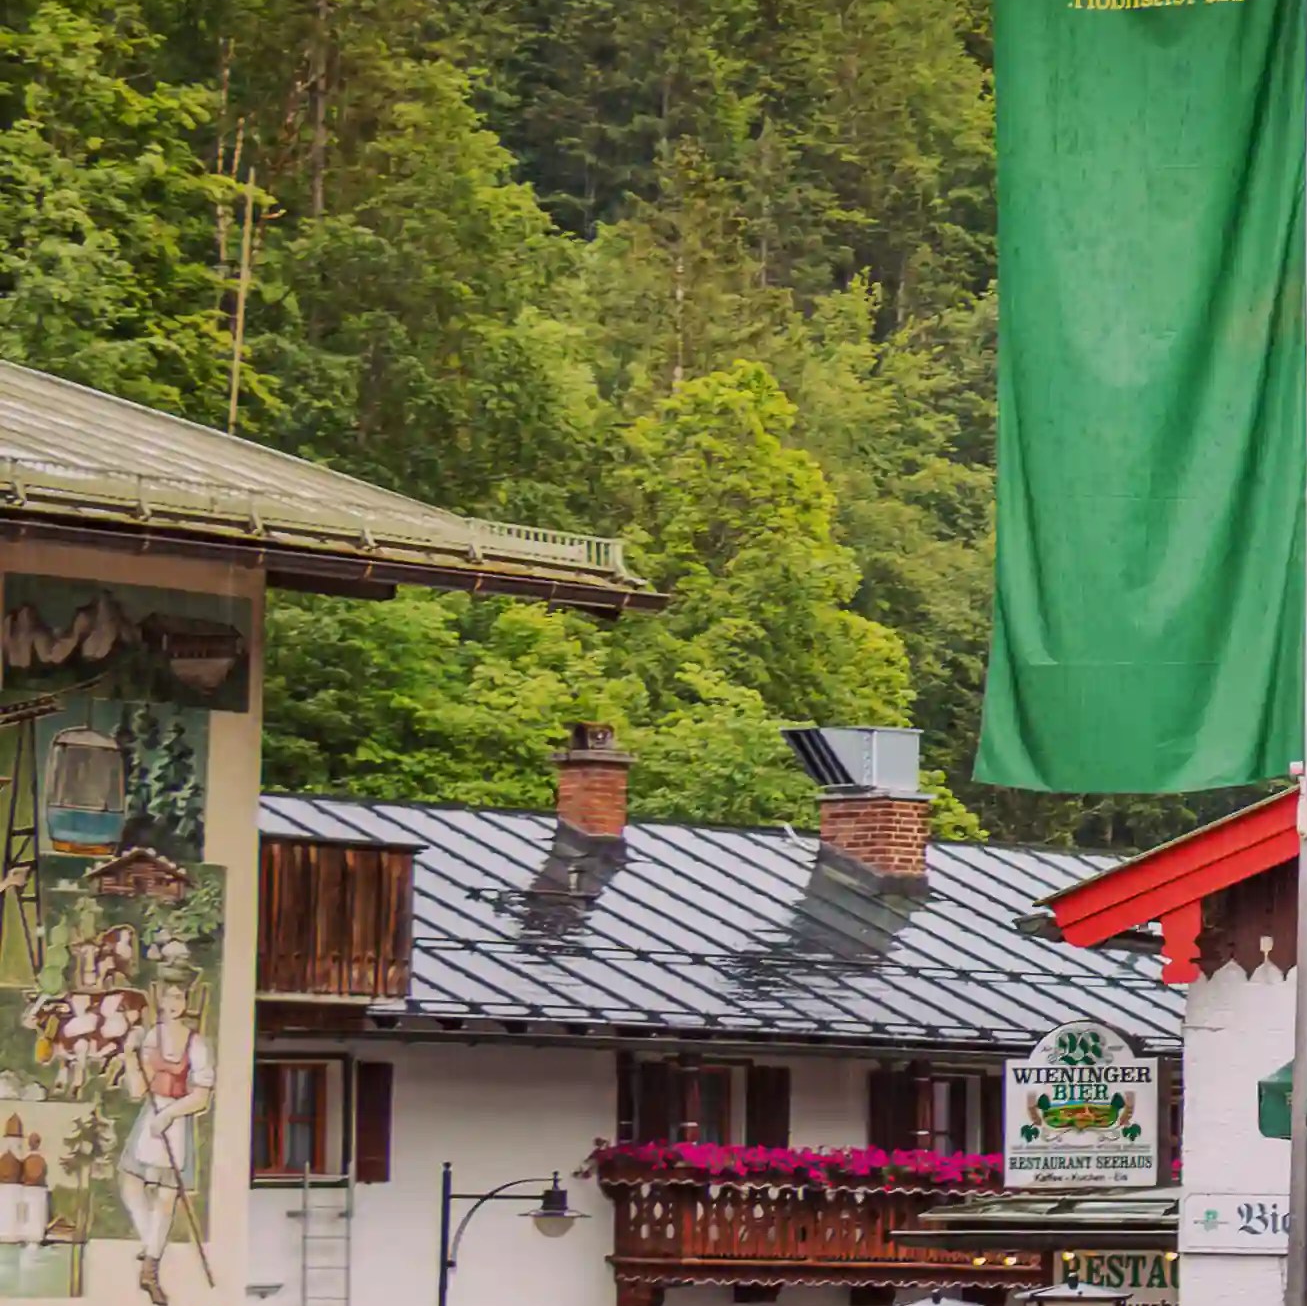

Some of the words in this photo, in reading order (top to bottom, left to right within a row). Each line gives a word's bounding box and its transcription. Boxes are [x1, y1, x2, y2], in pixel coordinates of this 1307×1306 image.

[1012, 1066, 1152, 1084] WIENINGER
[1052, 1083, 1109, 1101] BIER
[1009, 1156, 1092, 1170] RESTAURANT
[1096, 1155, 1152, 1169] SEEHAUS
